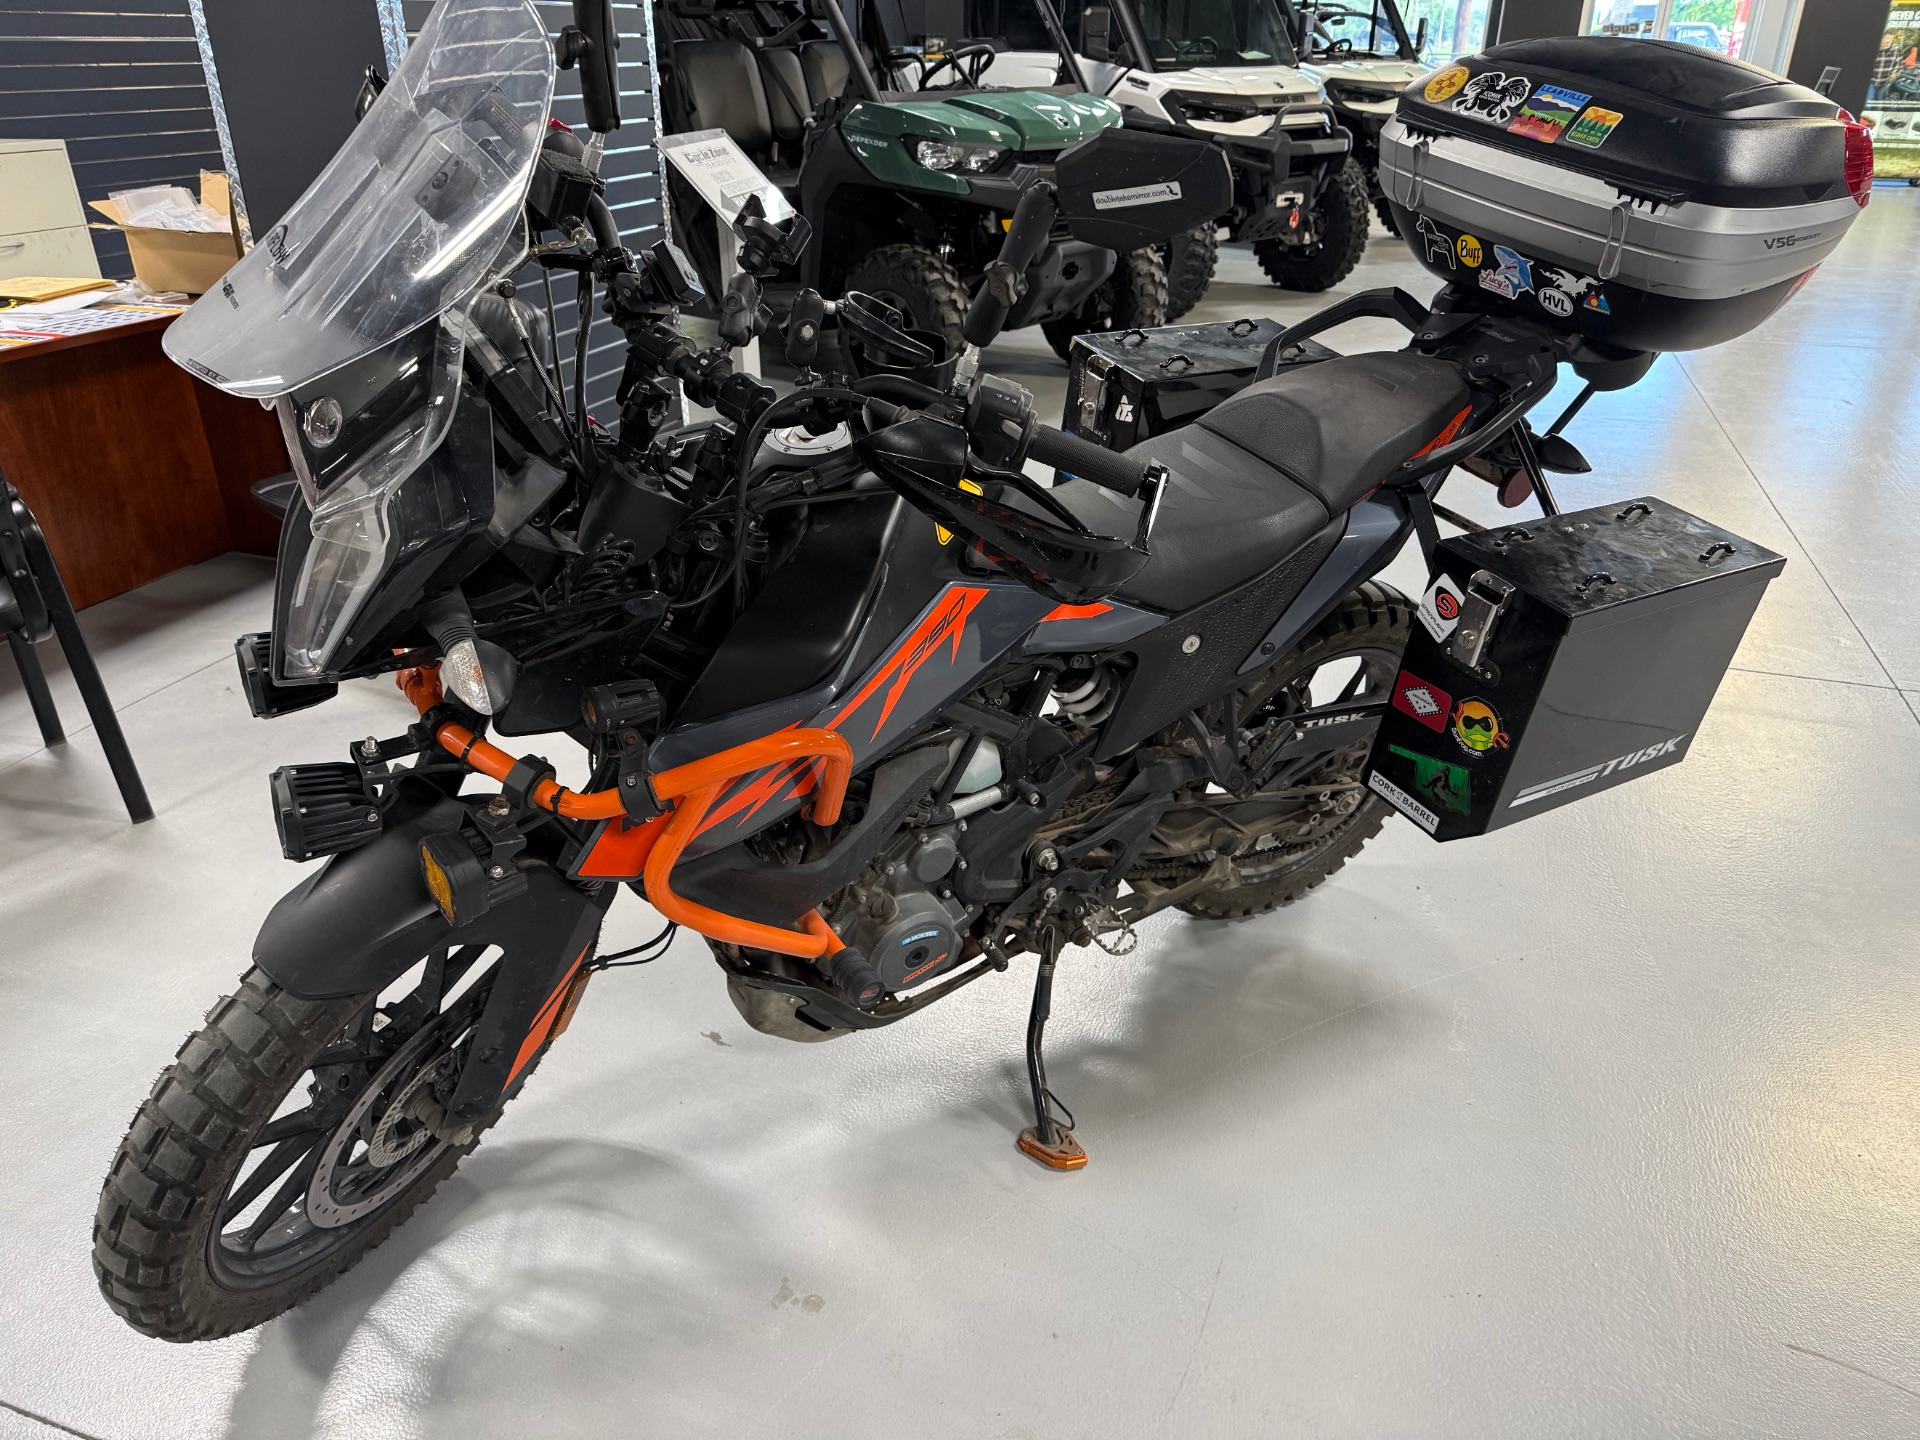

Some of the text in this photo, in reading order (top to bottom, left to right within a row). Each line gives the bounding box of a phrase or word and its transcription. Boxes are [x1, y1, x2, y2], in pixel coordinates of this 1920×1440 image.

[1890, 10, 1915, 21] NEVER
[1540, 86, 1589, 102] LEADVILLE
[851, 134, 888, 149] DEFENDER
[1570, 131, 1587, 140] BEAVER
[1587, 134, 1600, 143] CREEK
[684, 146, 730, 164] Cycle Zone
[1095, 188, 1168, 207] doubletakemirror.com
[1763, 235, 1796, 250] V56
[1480, 269, 1510, 289] Lucy's
[1543, 291, 1568, 313] HVL
[208, 368, 217, 379] BY
[1440, 422, 1458, 447] NTURE
[903, 591, 967, 675] 390
[1412, 693, 1433, 707] ARKANSAS
[1303, 712, 1368, 728] TUSK
[1600, 730, 1690, 777] TUSK
[1372, 774, 1435, 827] CORK BARREL
[911, 930, 938, 941] MOTOREX
